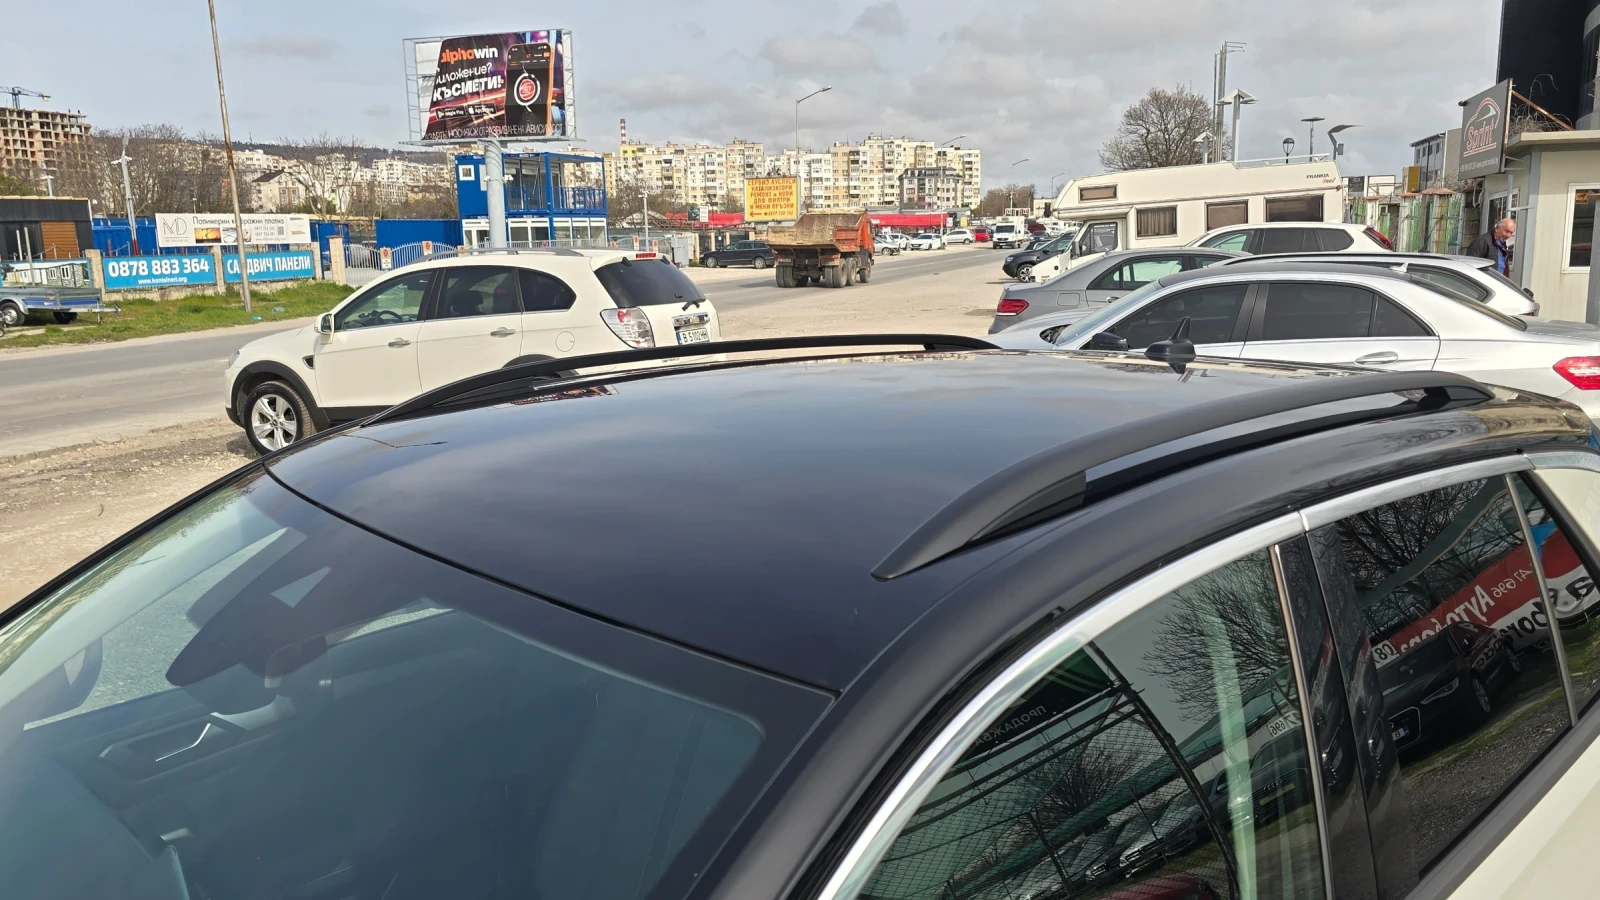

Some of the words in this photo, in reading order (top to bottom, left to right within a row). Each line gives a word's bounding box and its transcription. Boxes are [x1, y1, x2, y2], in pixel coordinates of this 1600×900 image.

[440, 45, 498, 65] alphawin
[1467, 118, 1495, 152] Sprint
[108, 261, 149, 278] 0878
[152, 260, 180, 275] 883
[182, 258, 210, 274] 364
[227, 258, 273, 276] САДВИЧ
[275, 256, 311, 271] ПАНЕЛИ
